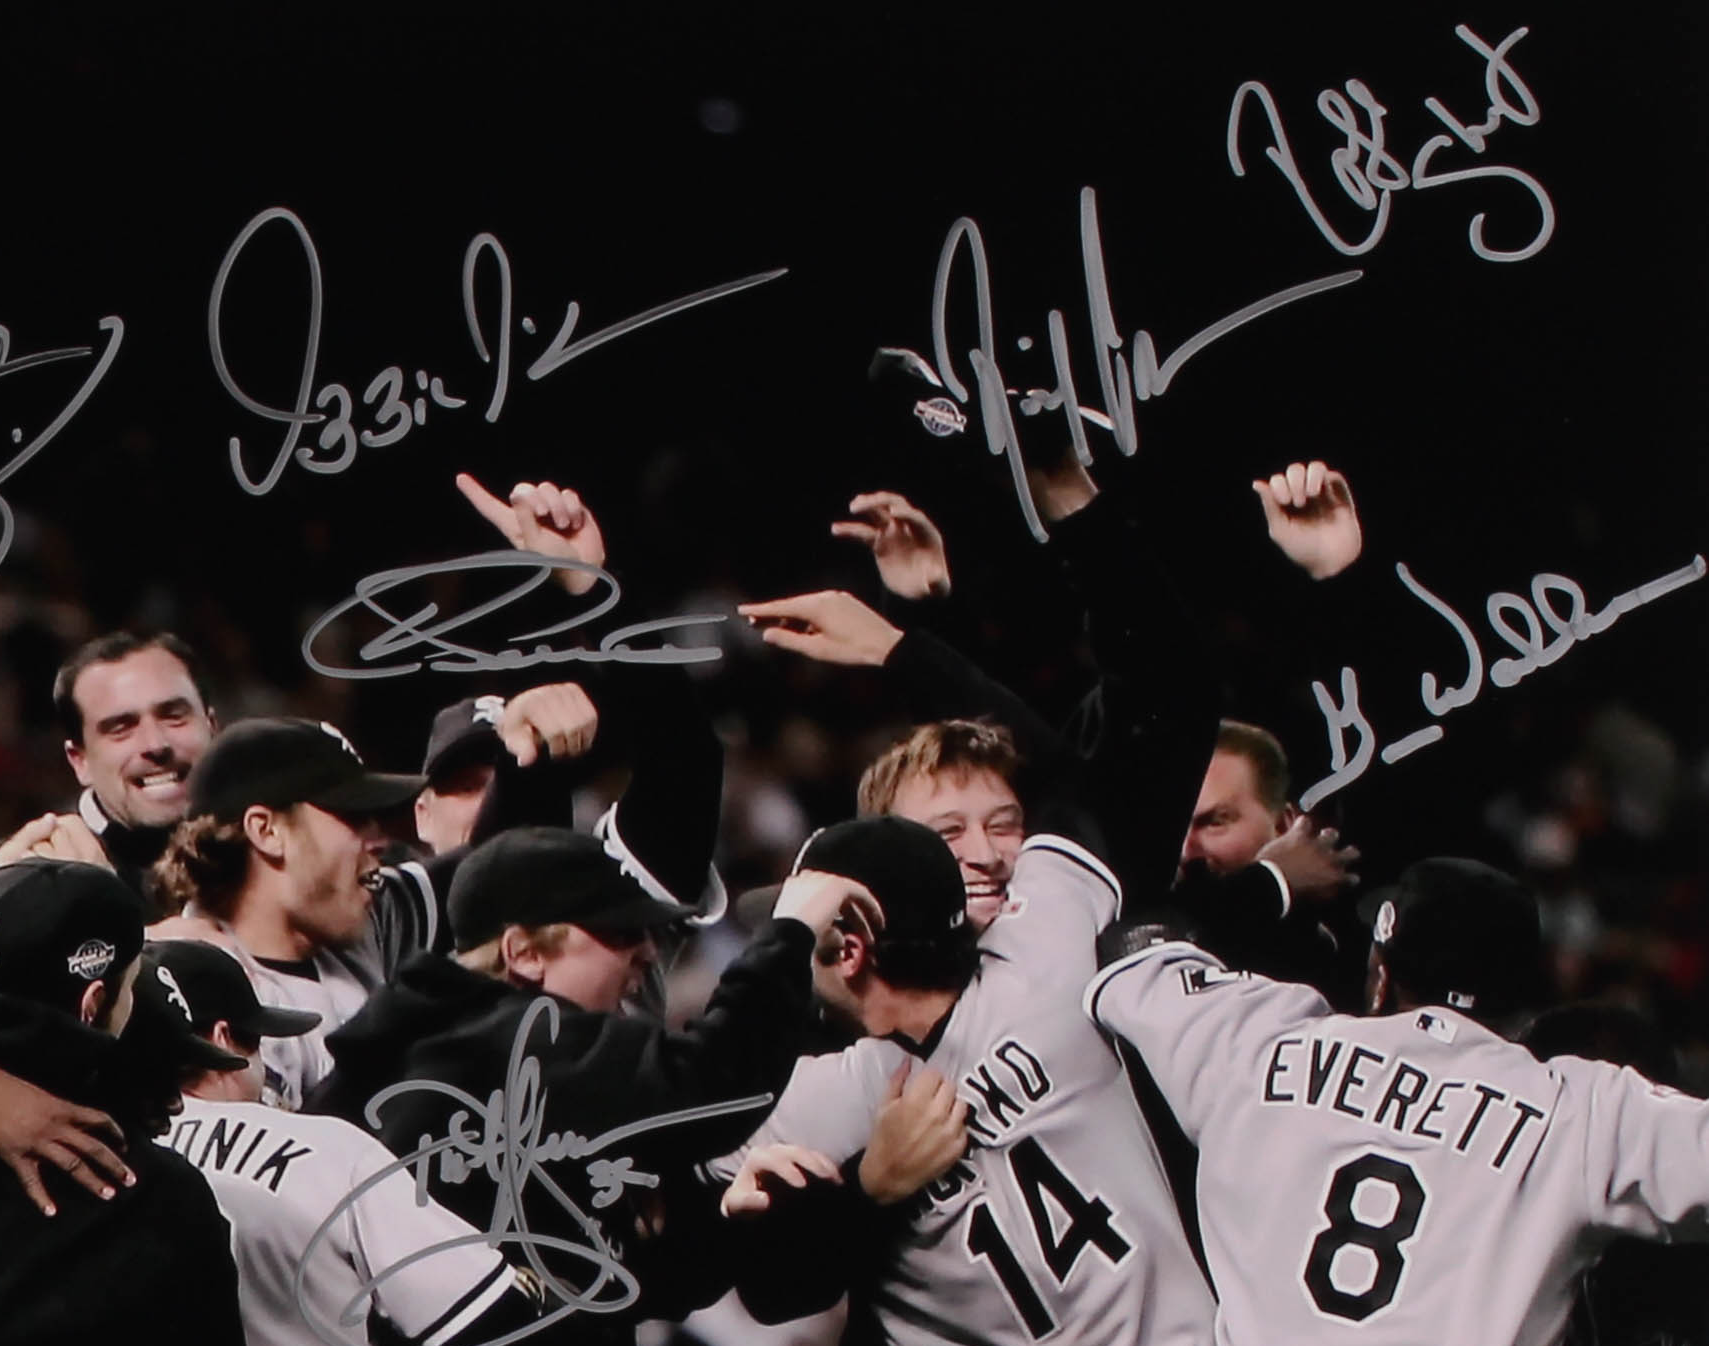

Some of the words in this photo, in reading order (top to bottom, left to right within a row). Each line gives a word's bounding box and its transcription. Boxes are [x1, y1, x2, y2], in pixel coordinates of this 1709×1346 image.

[1263, 1037, 1546, 1170] EVERETT
[965, 1134, 1133, 1341] 14
[1302, 1151, 1427, 1324] 8
